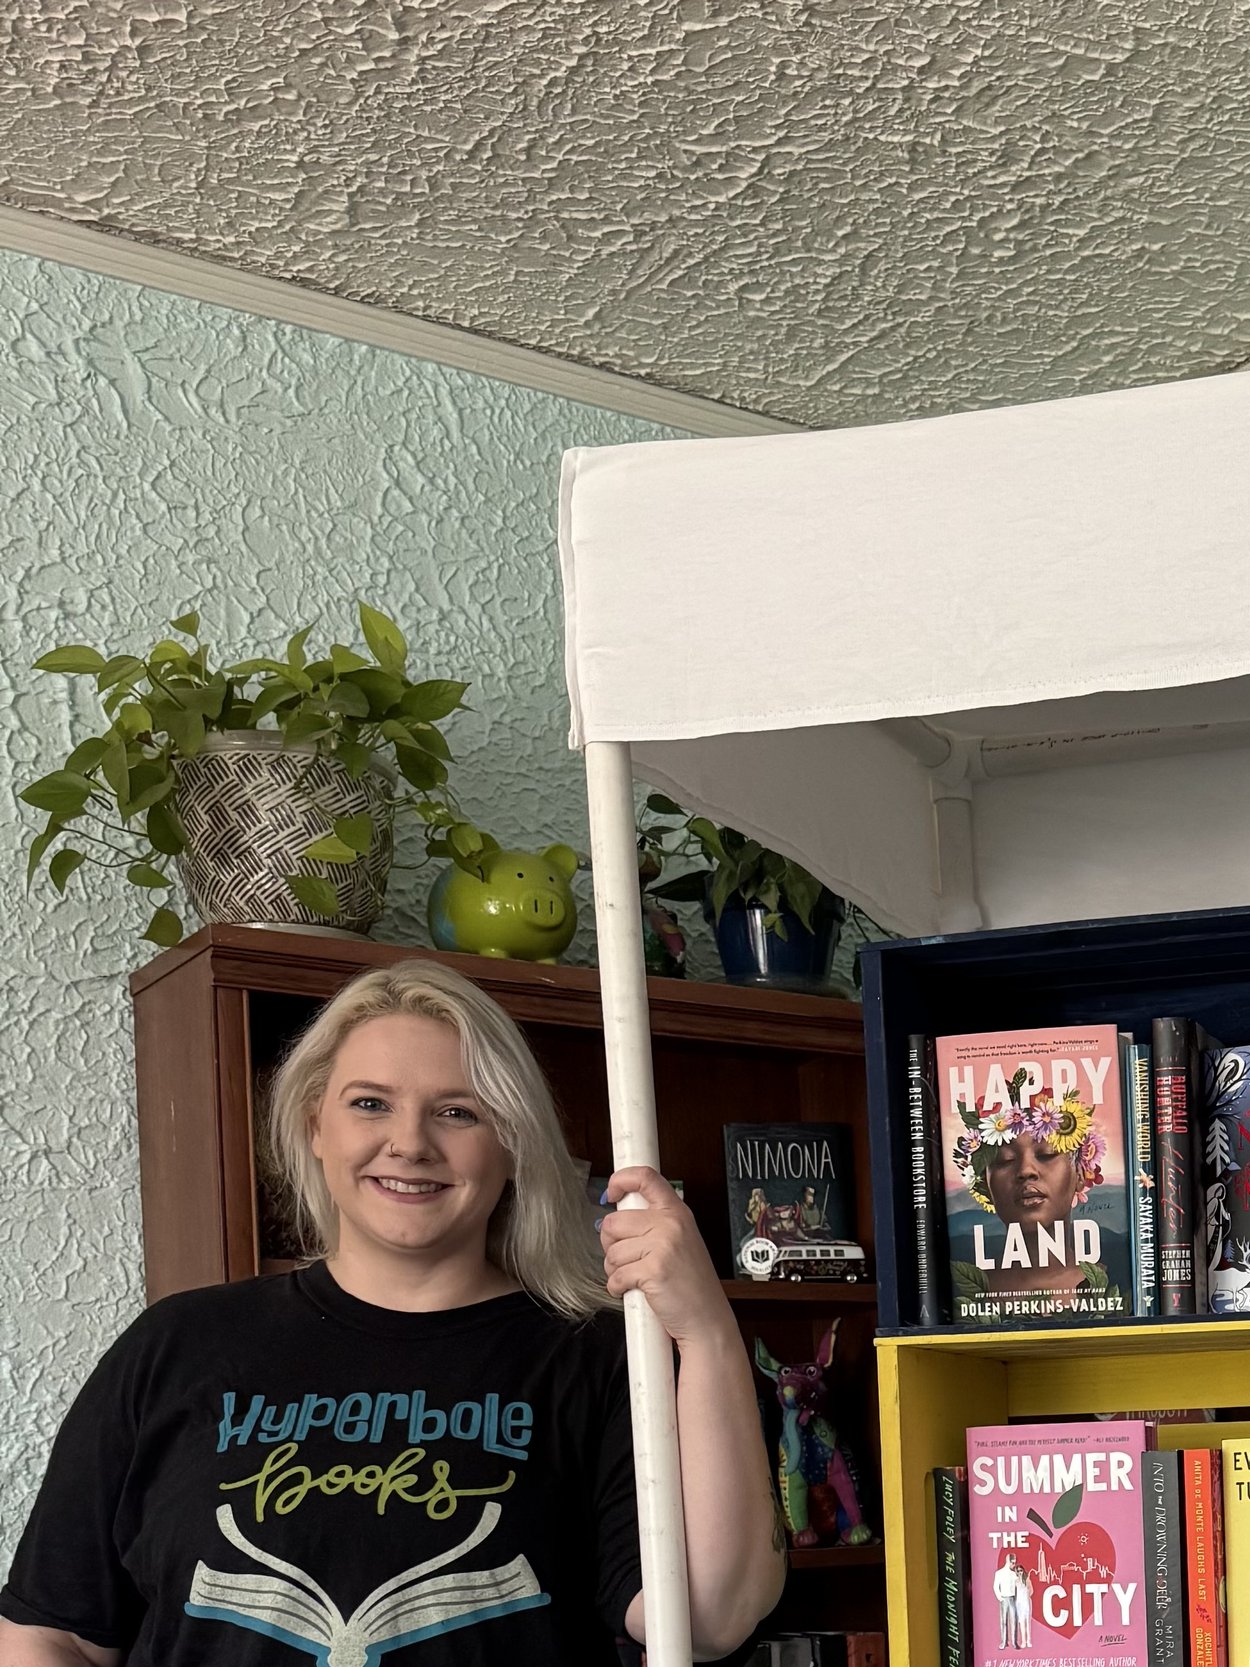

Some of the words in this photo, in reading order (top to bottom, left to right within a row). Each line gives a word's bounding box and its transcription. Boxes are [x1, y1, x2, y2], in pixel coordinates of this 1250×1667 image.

[909, 1049, 917, 1062] THE
[908, 1065, 924, 1140] IN-BETWEEN
[949, 1056, 1112, 1113] HAPPY
[1134, 1058, 1150, 1118] VANISHING
[1156, 1075, 1173, 1134] HUNTER
[1171, 1075, 1188, 1133] BUFFALO
[736, 1139, 836, 1180] NIMONA
[1136, 1120, 1151, 1162] WORLD
[911, 1146, 926, 1210] BOOKSTORE
[916, 1220, 927, 1254] EDWARD
[1138, 1196, 1154, 1241] SAYAKA
[973, 1219, 1101, 1270] LAND
[1161, 1250, 1191, 1260] STEPHEN
[917, 1255, 928, 1294] UNDERHILL
[1140, 1243, 1156, 1290] MURATA
[1161, 1260, 1191, 1270] GRAHAM
[1161, 1269, 1192, 1281] JONES
[961, 1301, 1001, 1317] DOLEN
[1005, 1296, 1124, 1316] PERKINS-VALDEZ
[219, 1442, 516, 1523] books
[942, 1475, 954, 1506] LUCY
[972, 1451, 1134, 1496] SUMMER
[1152, 1462, 1164, 1493] INTO
[1194, 1460, 1202, 1487] ANITA
[943, 1507, 956, 1543] FOLEY
[997, 1505, 1018, 1523] IN
[1196, 1502, 1204, 1532] MONTE
[988, 1531, 1030, 1549] THE
[1155, 1506, 1169, 1578] DROWNING
[1196, 1535, 1205, 1580] LAUGHS
[945, 1552, 955, 1574] THE
[946, 1578, 959, 1643] MIDNIGHT
[1042, 1582, 1138, 1628] CITY
[1197, 1582, 1206, 1601] LAST
[1155, 1618, 1165, 1664] GRANT
[1165, 1625, 1174, 1659] MIRA
[1204, 1632, 1213, 1667] XOCHITL
